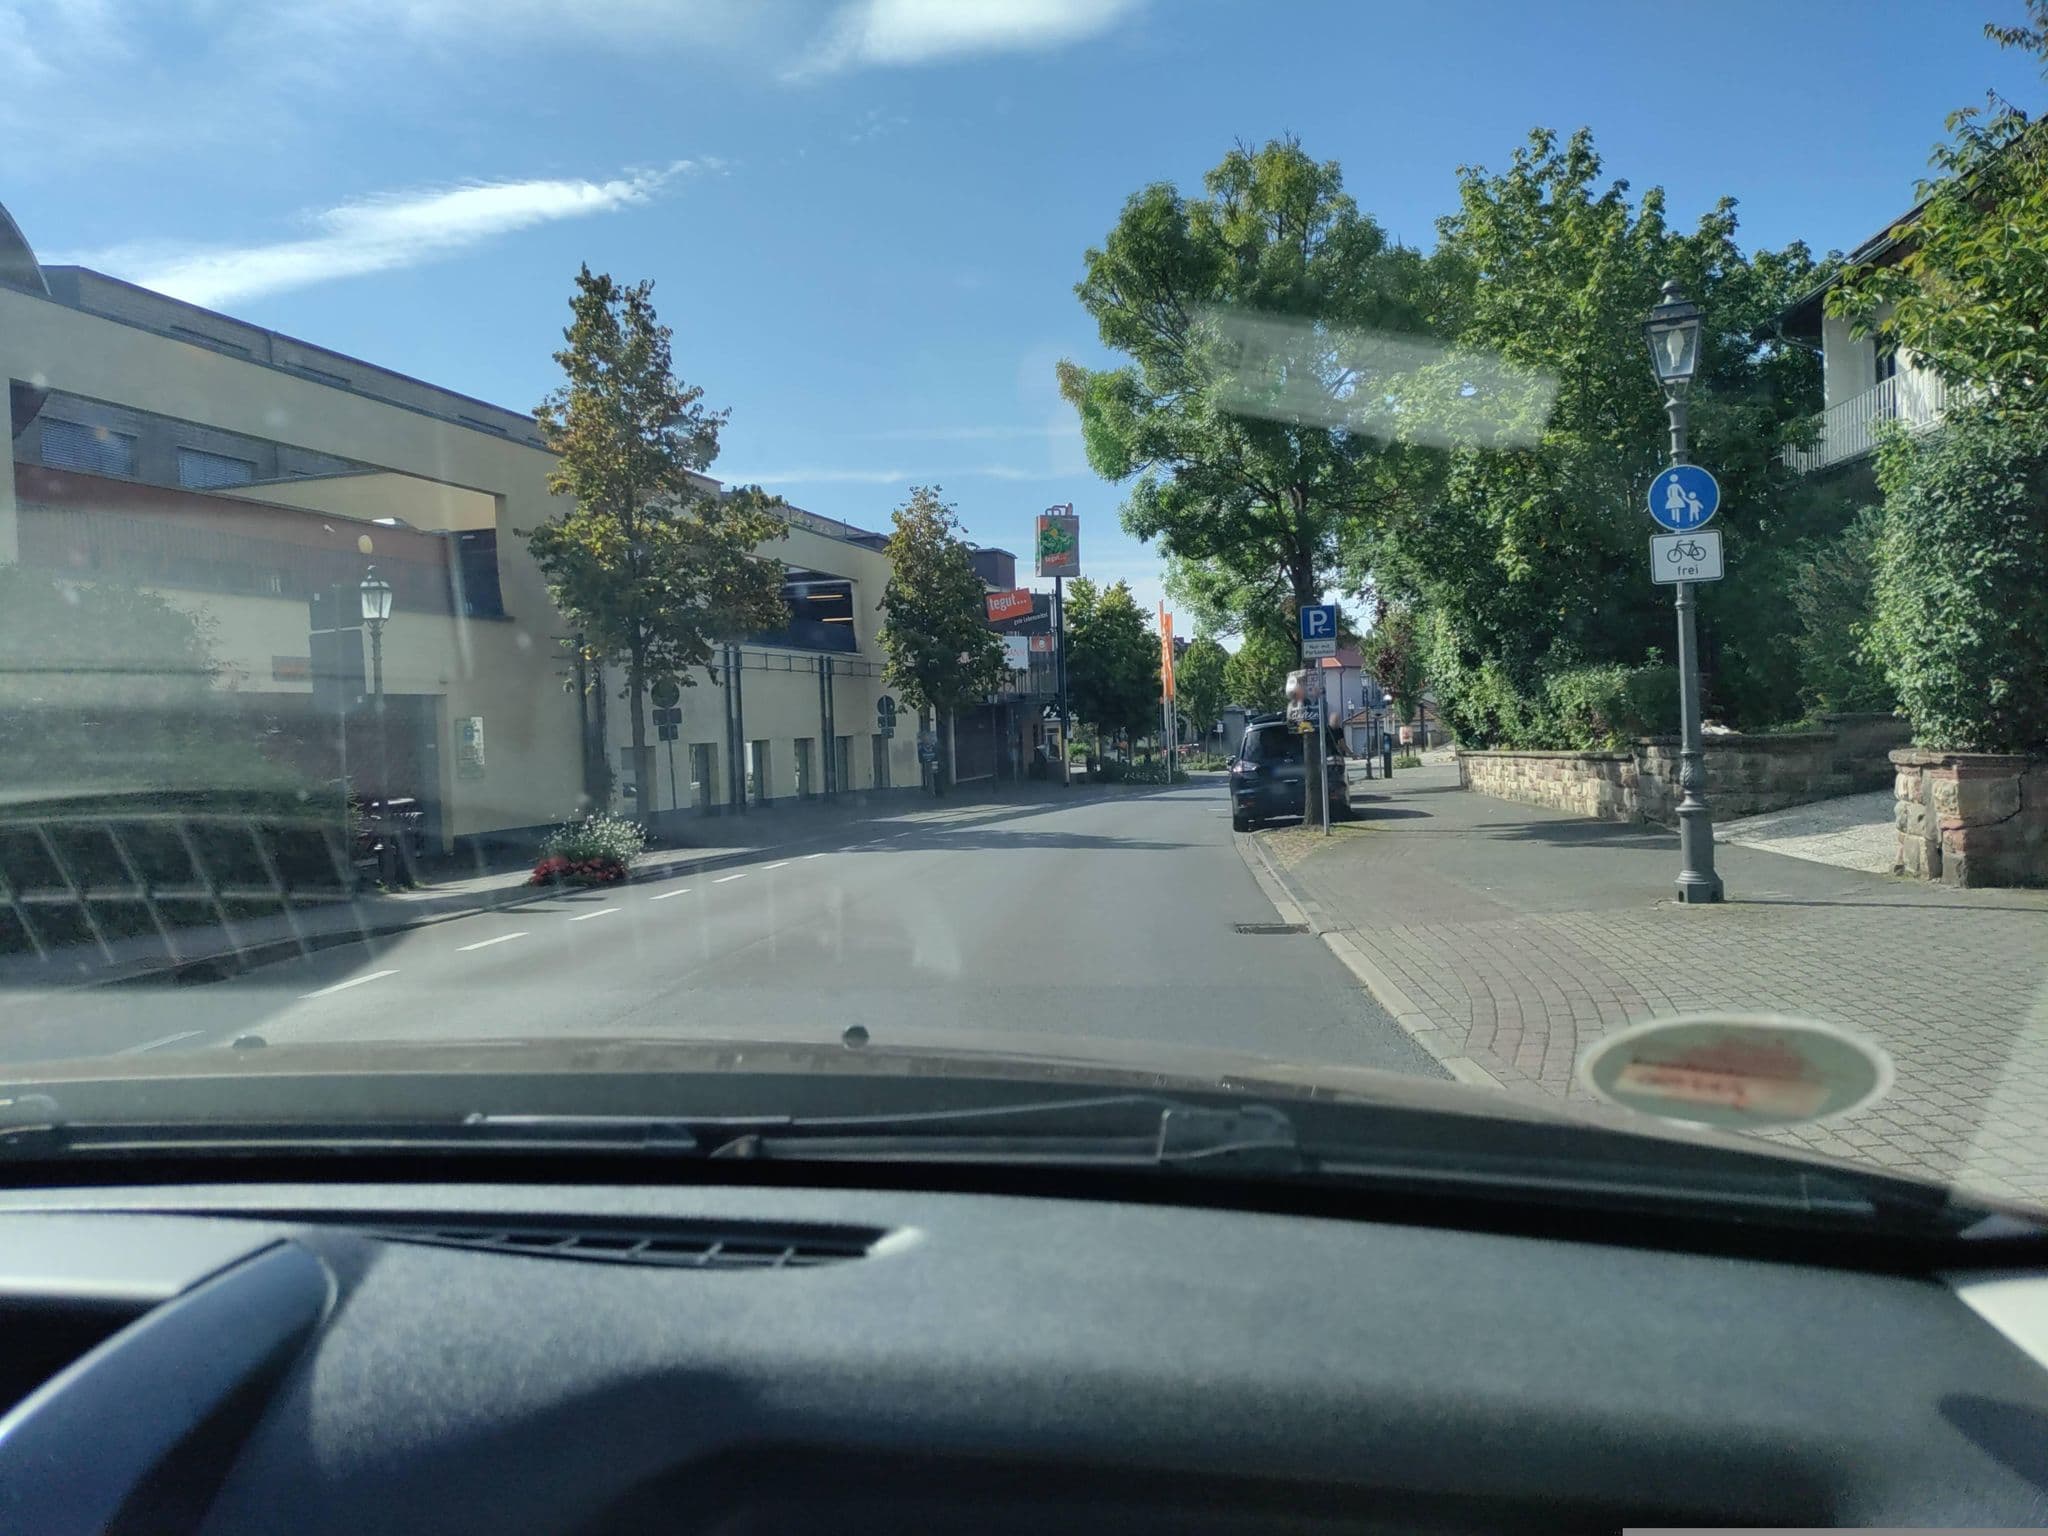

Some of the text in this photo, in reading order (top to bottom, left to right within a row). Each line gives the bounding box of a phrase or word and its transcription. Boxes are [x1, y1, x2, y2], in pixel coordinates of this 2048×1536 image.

[1677, 564, 1699, 576] frei
[990, 593, 1027, 611] tegut...
[1309, 610, 1328, 636] P
